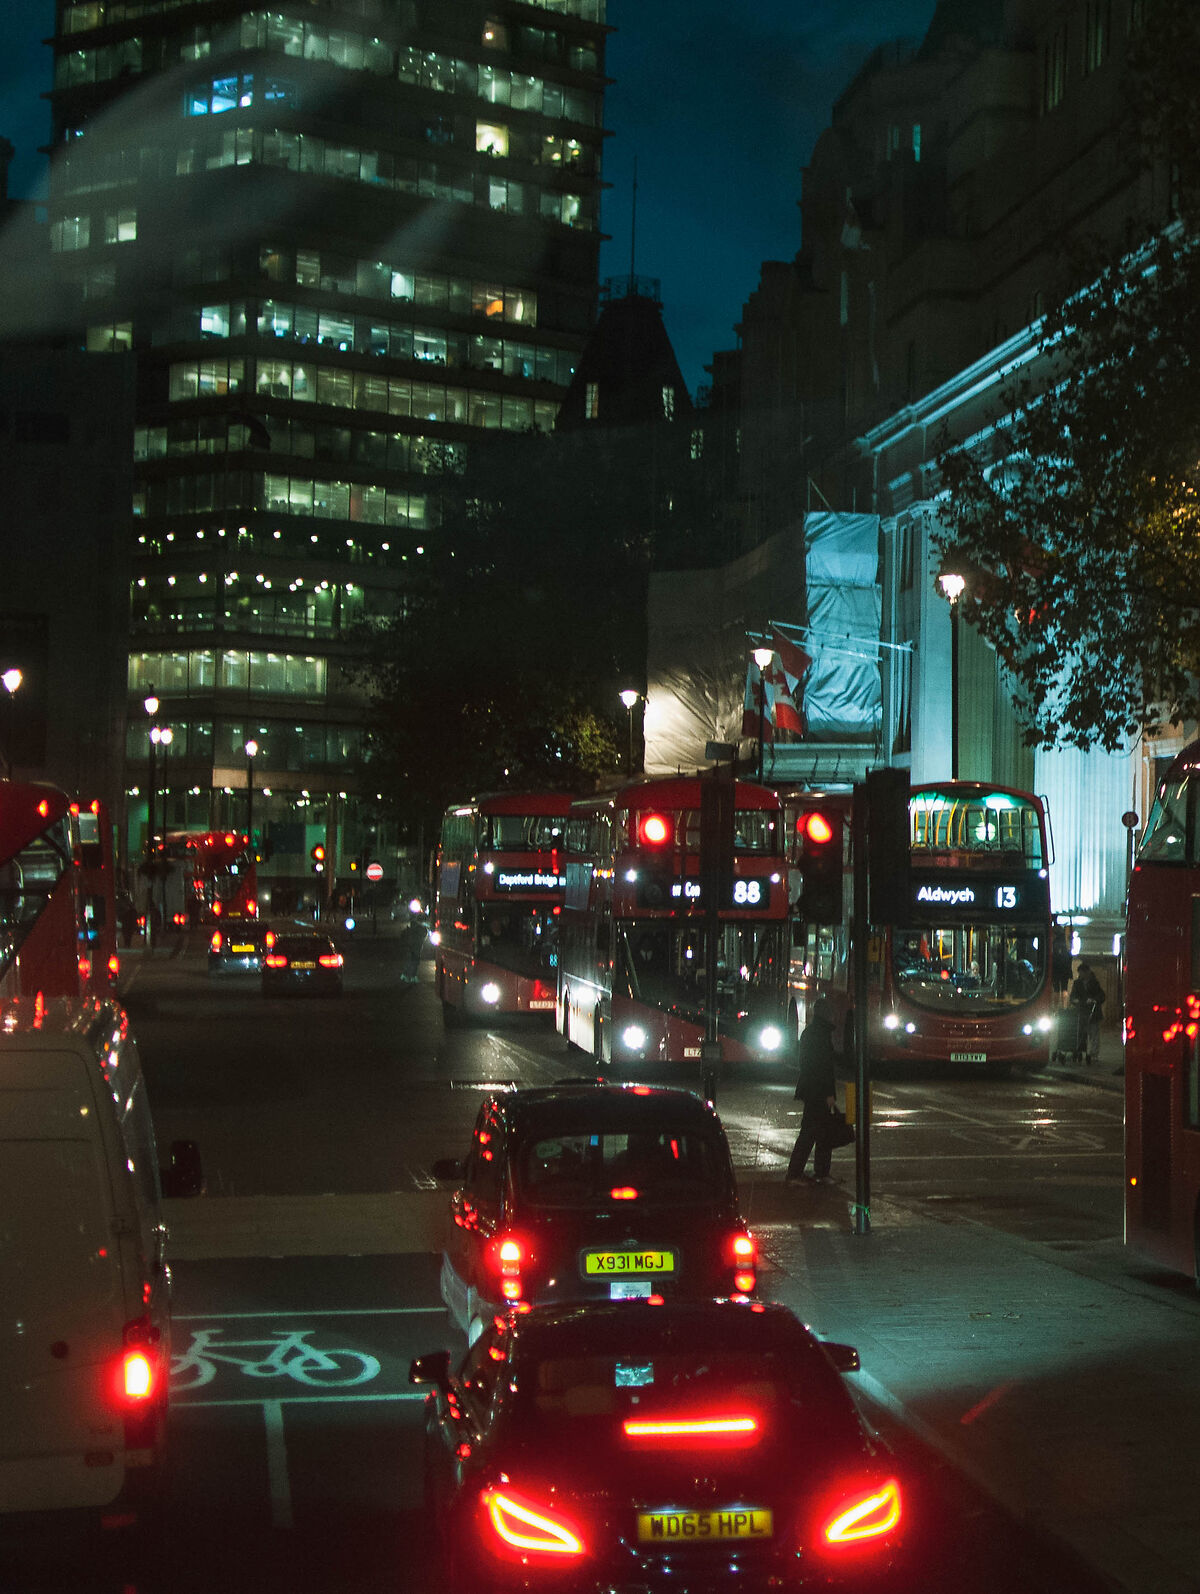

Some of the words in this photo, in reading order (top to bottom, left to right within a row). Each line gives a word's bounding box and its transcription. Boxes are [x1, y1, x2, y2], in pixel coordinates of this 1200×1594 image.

[534, 873, 558, 888] Bridge
[733, 880, 760, 904] 88
[918, 886, 975, 905] Aldwych
[997, 886, 1016, 908] 13
[596, 1256, 629, 1270] X931
[635, 1255, 664, 1269] MGJ
[651, 1515, 711, 1537] WD65
[718, 1513, 763, 1535] HPL
